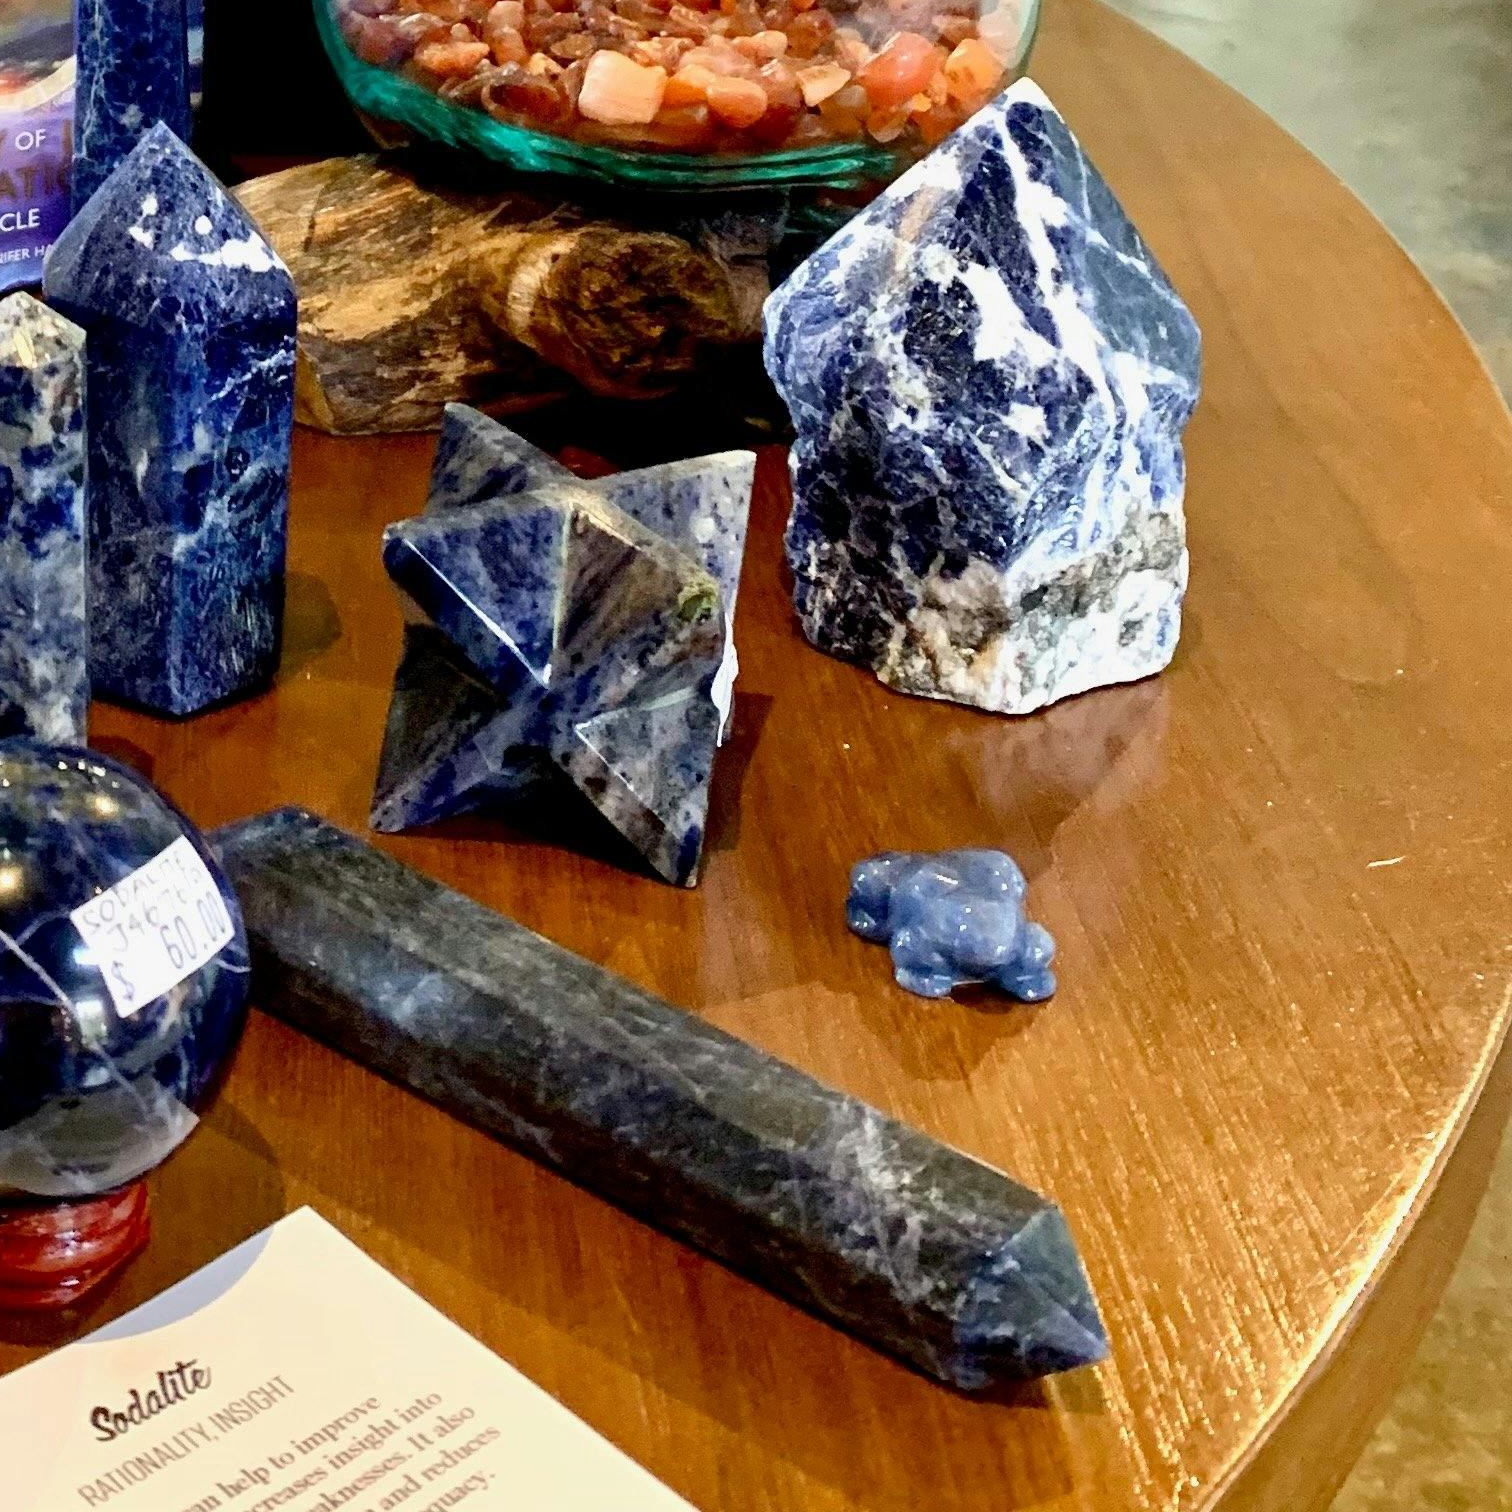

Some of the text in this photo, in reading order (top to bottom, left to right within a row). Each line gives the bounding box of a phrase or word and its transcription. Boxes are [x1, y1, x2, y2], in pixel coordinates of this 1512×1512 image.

[14, 129, 47, 152] OF
[160, 891, 226, 970] 60.00
[78, 1375, 295, 1507] RATIONALITY, INSIGHT
[90, 1359, 212, 1442] Sodalite
[322, 1419, 400, 1469] insight
[394, 1392, 442, 1424] into
[408, 1433, 434, 1451] It
[437, 1404, 476, 1438] also
[216, 1466, 271, 1499] help
[268, 1452, 295, 1469] to
[290, 1395, 381, 1456] improve
[380, 1427, 501, 1510] and reduces
